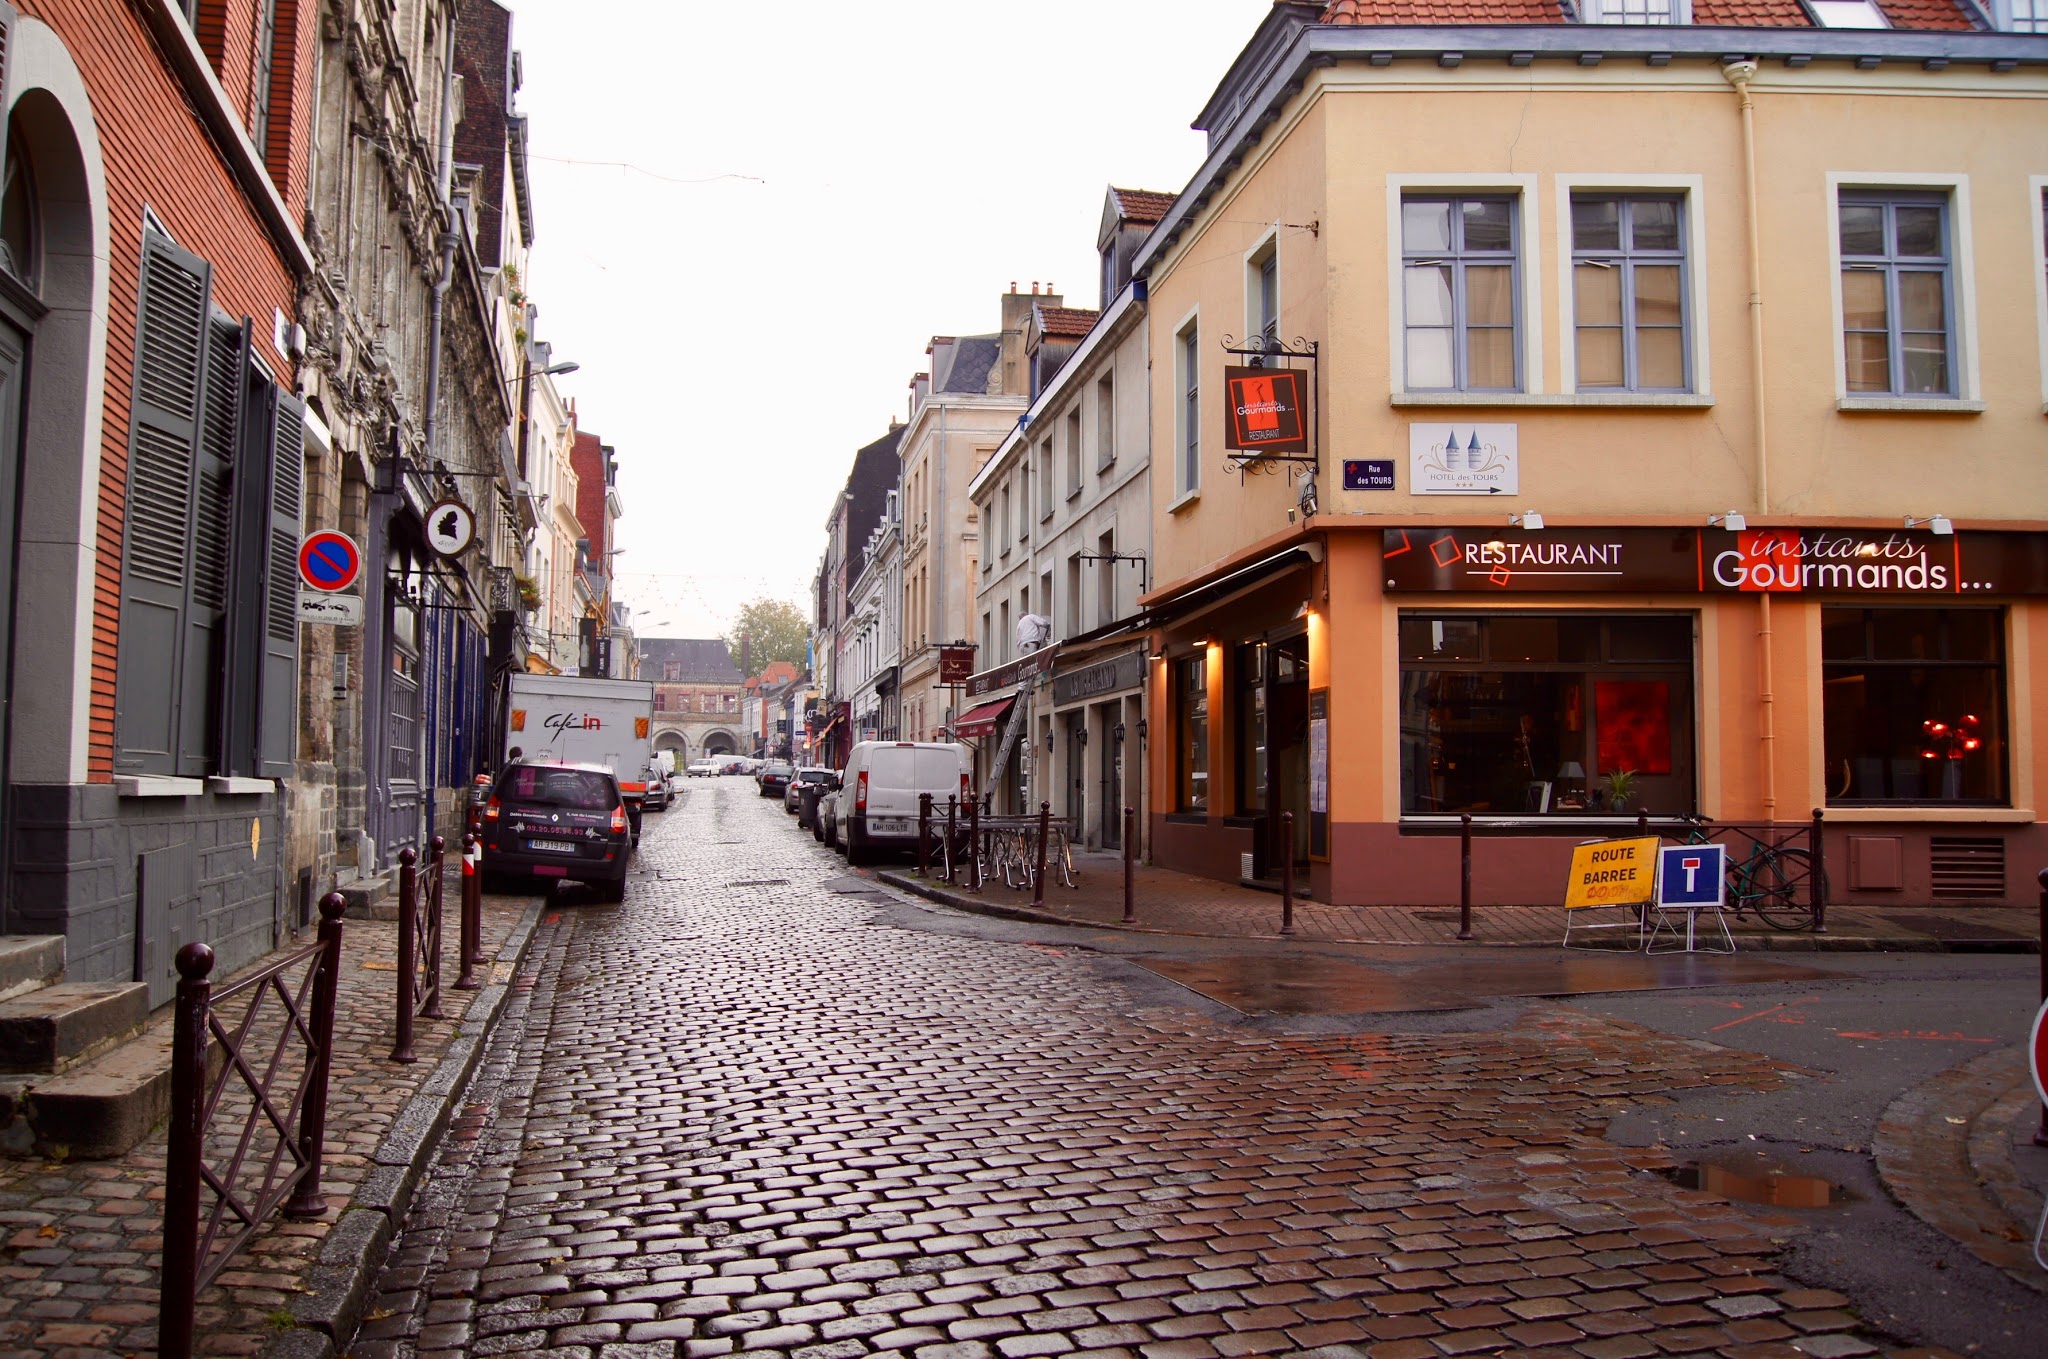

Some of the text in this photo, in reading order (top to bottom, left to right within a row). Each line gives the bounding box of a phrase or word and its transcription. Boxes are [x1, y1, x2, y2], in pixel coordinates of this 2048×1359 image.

[1237, 404, 1286, 415] Gourmands
[1248, 428, 1280, 441] RESTAURANT
[1368, 465, 1381, 473] Rue
[1357, 476, 1392, 485] des TOURS
[1750, 531, 1925, 559] instants
[1465, 543, 1623, 565] RESTAURANT
[1712, 550, 1947, 590] Gourmands
[544, 713, 601, 744] Café in
[1592, 847, 1635, 863] ROUTE
[1583, 868, 1637, 885] BARREE
